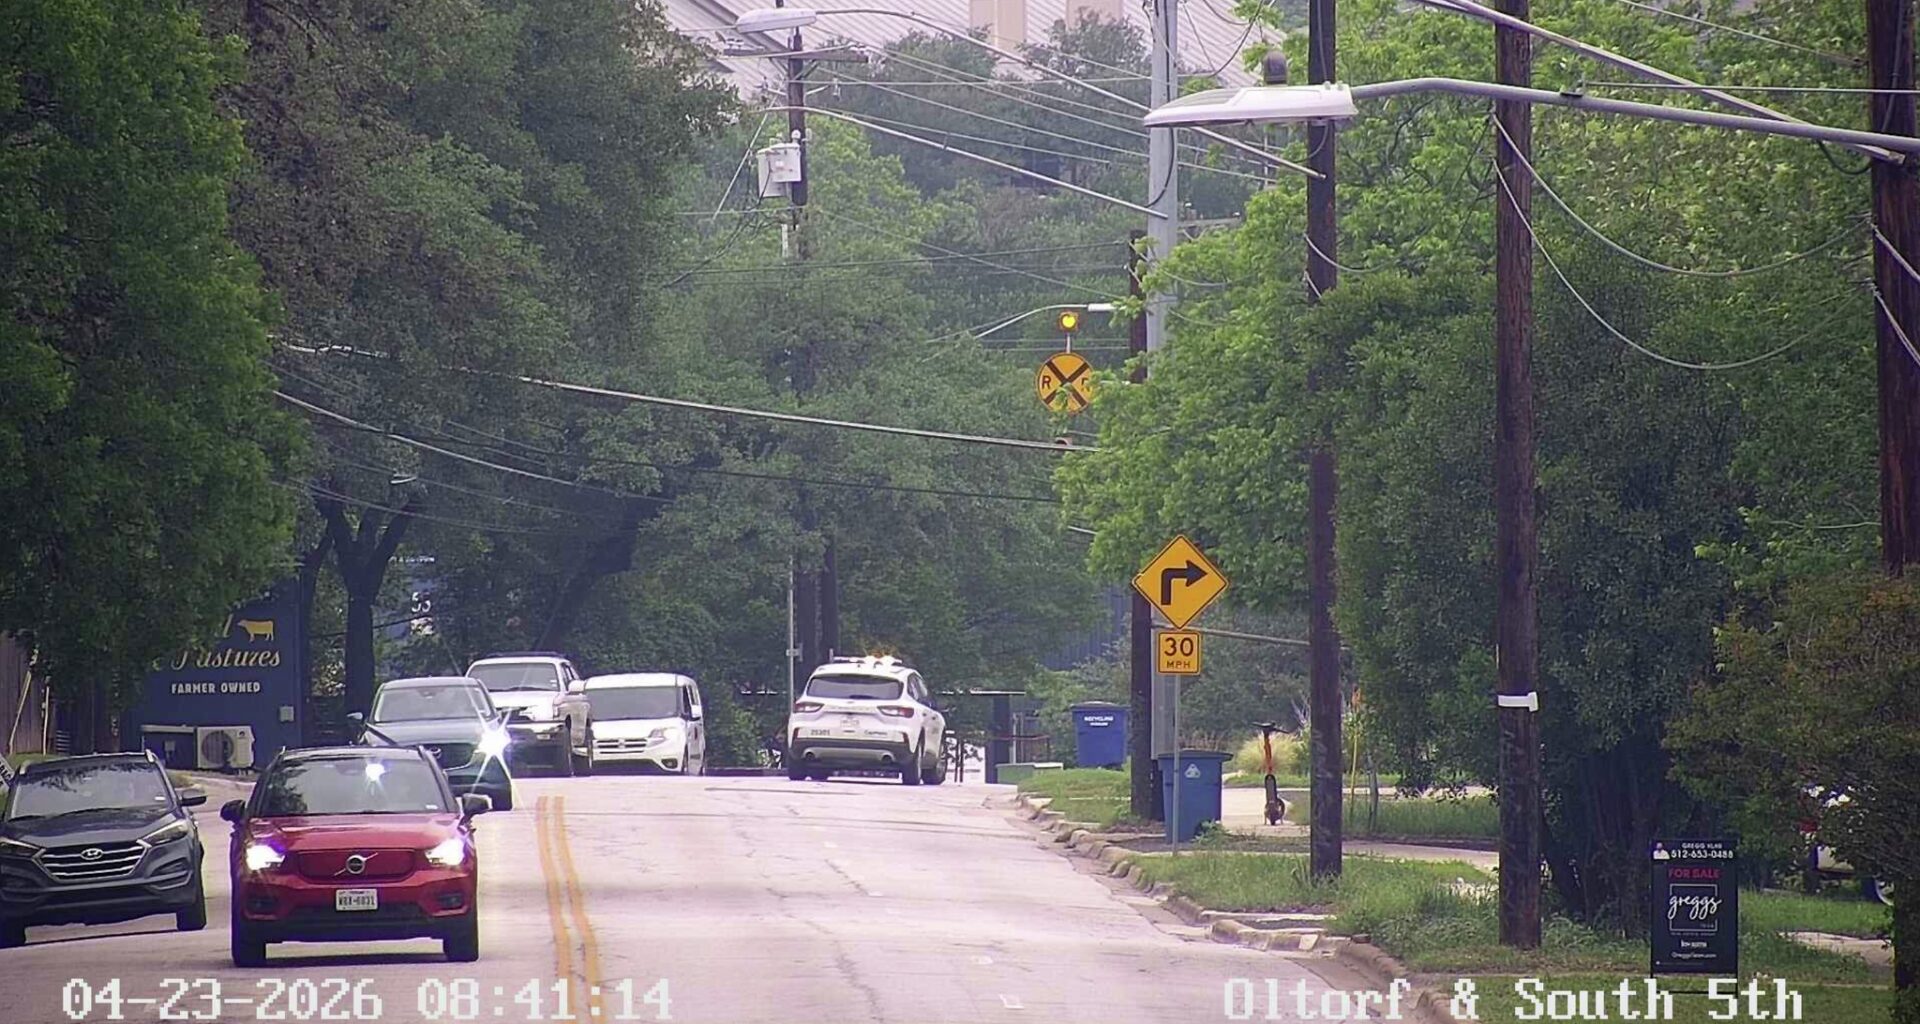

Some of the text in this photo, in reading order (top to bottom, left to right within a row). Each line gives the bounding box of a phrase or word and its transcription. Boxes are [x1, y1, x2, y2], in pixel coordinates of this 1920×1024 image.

[1041, 375, 1051, 390] R
[1164, 637, 1194, 657] 30
[1166, 660, 1191, 669] MPH
[171, 681, 261, 694] FARMER OWNED
[1667, 868, 1721, 879] FOR SALE
[1667, 895, 1722, 920] greggs
